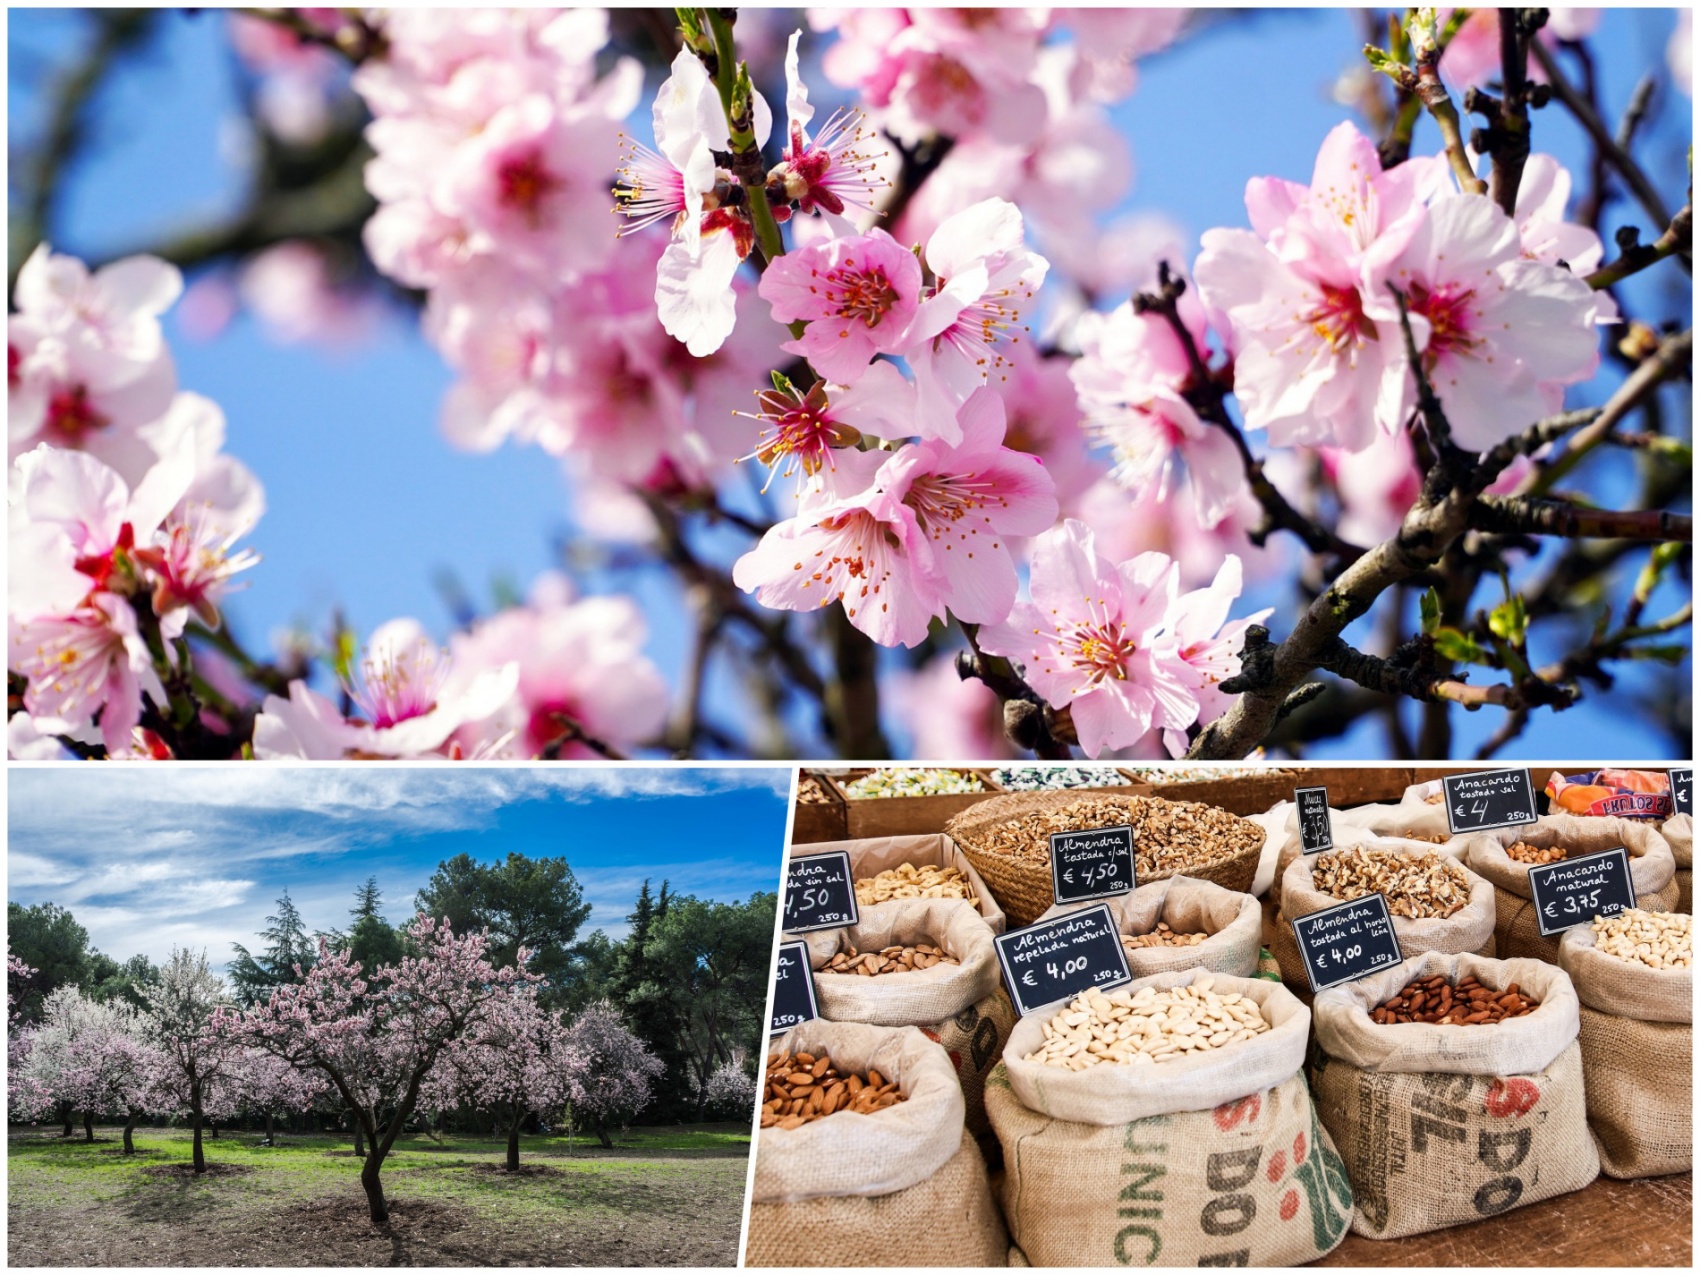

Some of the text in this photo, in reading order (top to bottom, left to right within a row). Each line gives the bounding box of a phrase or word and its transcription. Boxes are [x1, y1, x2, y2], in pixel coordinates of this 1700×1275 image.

[1454, 773, 1520, 791] Anacardo
[1460, 785, 1517, 799] tostado sal
[1676, 789, 1688, 802] €
[1454, 799, 1488, 823] € 4
[1058, 836, 1123, 852] Almendra
[1063, 850, 1105, 863] tostada
[805, 877, 822, 886] sin
[826, 871, 844, 883] sal
[1063, 863, 1117, 888] € 4,50
[1543, 859, 1614, 886] Anacardo
[1556, 874, 1609, 892] natural
[1544, 888, 1601, 918] € 3,75
[1308, 908, 1373, 935] Almendra
[1013, 919, 1096, 951] Almendra
[1013, 924, 1111, 963] repelada natural
[1310, 930, 1347, 947] tostada
[1350, 922, 1362, 934] al
[1316, 945, 1362, 968] € 4,00
[1022, 956, 1088, 986] € 4,00
[1473, 1127, 1532, 1215] DO
